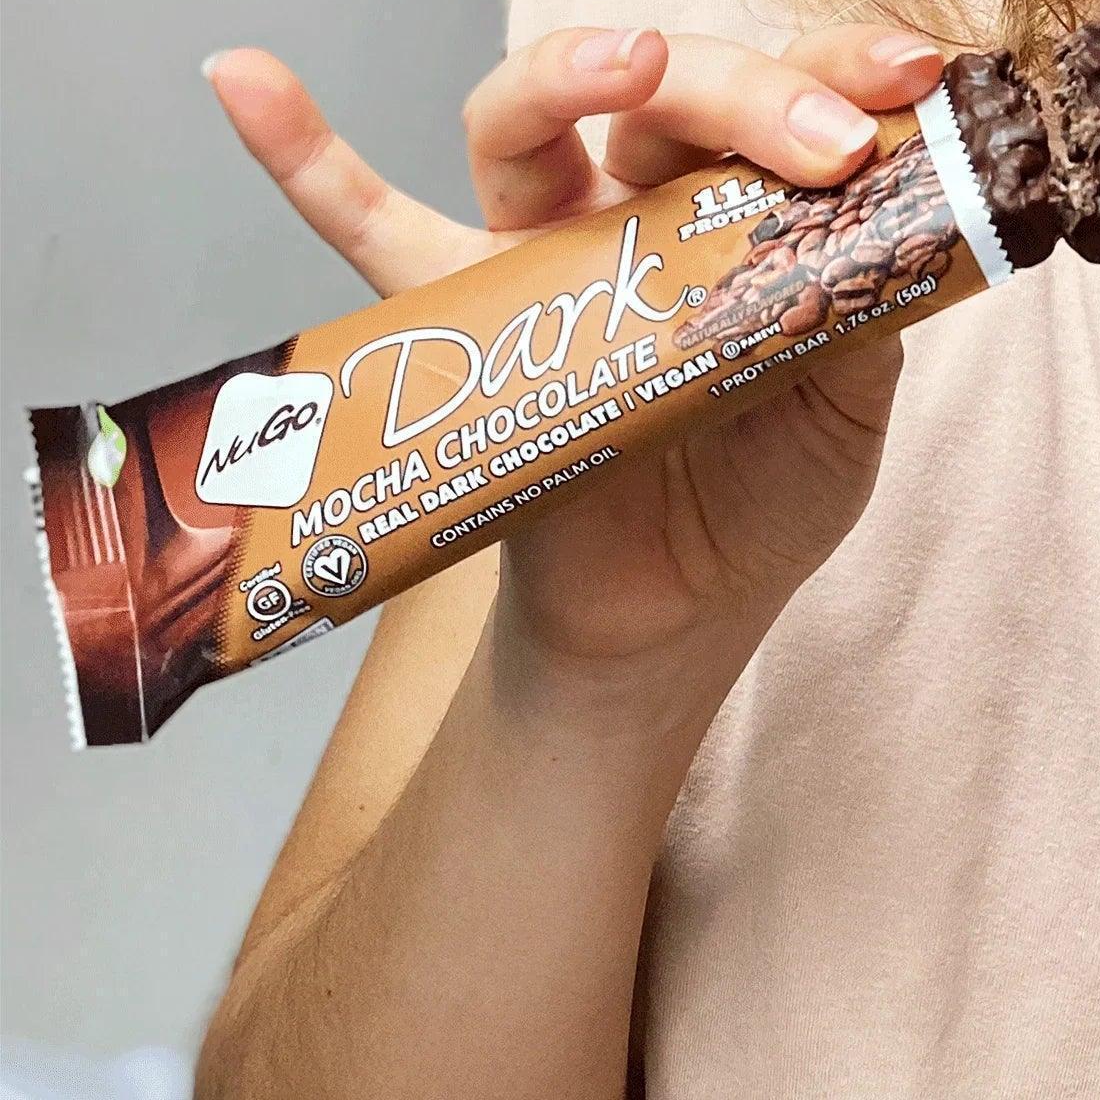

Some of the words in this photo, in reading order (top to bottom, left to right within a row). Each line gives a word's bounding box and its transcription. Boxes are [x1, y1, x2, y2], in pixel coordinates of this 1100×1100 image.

[678, 189, 786, 242] PROTEIN
[339, 215, 689, 449] Dark
[709, 385, 721, 398] 1
[794, 331, 831, 355] BAR
[834, 310, 869, 335] 1.76
[896, 275, 937, 307] (50g)
[290, 449, 431, 548] MOCHA
[435, 333, 659, 470] CHOCOLATE
[357, 505, 421, 545] REAL
[423, 464, 489, 514] DARK
[489, 400, 623, 478] CHOCOLATE
[634, 350, 719, 404] VEGAN
[430, 500, 514, 549] CONTAINS
[513, 484, 543, 506] NO
[543, 461, 590, 493] PALM
[589, 446, 621, 469] OIL
[256, 590, 281, 611] GF
